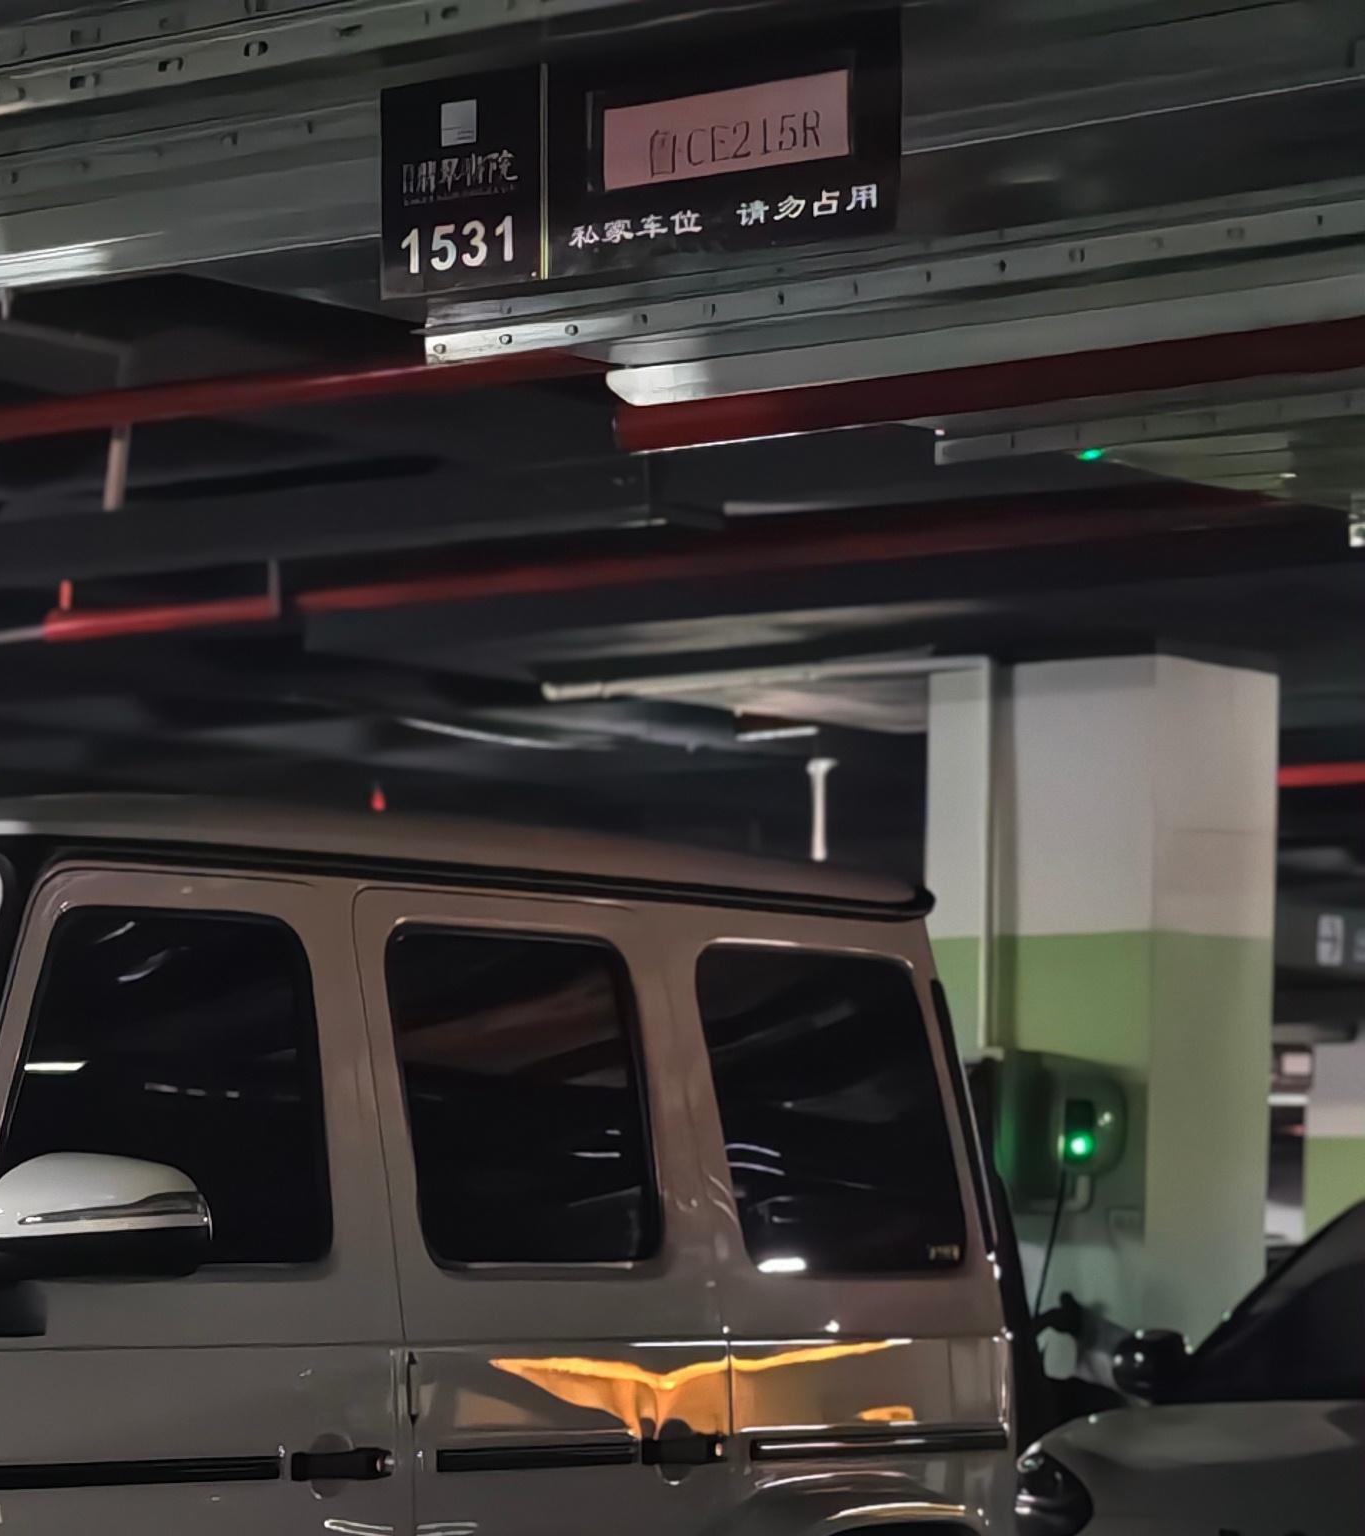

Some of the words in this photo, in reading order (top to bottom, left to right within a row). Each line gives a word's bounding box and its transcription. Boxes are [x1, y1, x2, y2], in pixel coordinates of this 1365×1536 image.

[400, 214, 516, 275] 1531
[568, 209, 703, 249] 私家车位
[735, 183, 879, 226] 请勿占用
